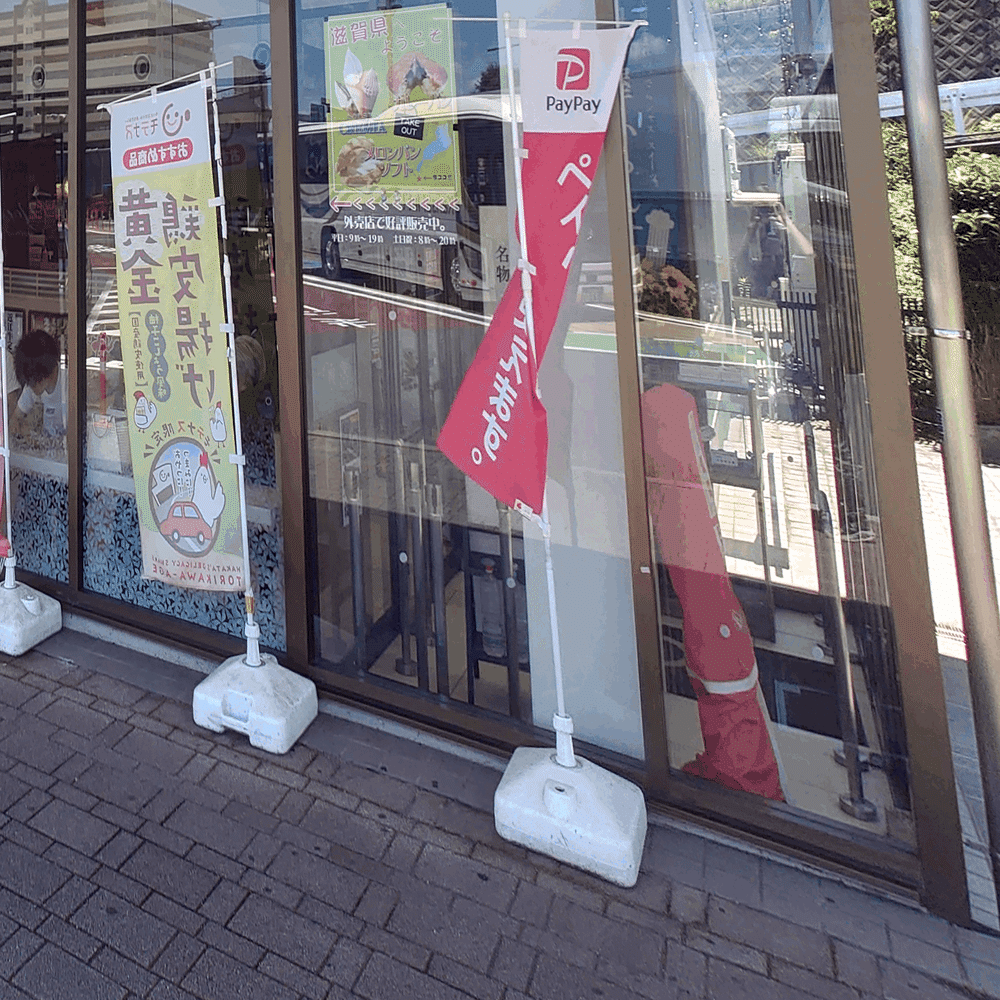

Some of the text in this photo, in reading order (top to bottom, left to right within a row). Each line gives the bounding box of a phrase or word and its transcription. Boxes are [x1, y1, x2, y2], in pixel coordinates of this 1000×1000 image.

[330, 16, 405, 47] 滋賀県へ
[381, 28, 442, 55] ようこそ
[546, 96, 601, 114] PayPay
[400, 126, 418, 136] OUT
[365, 145, 421, 162] メロンパン
[495, 245, 510, 282] 名物
